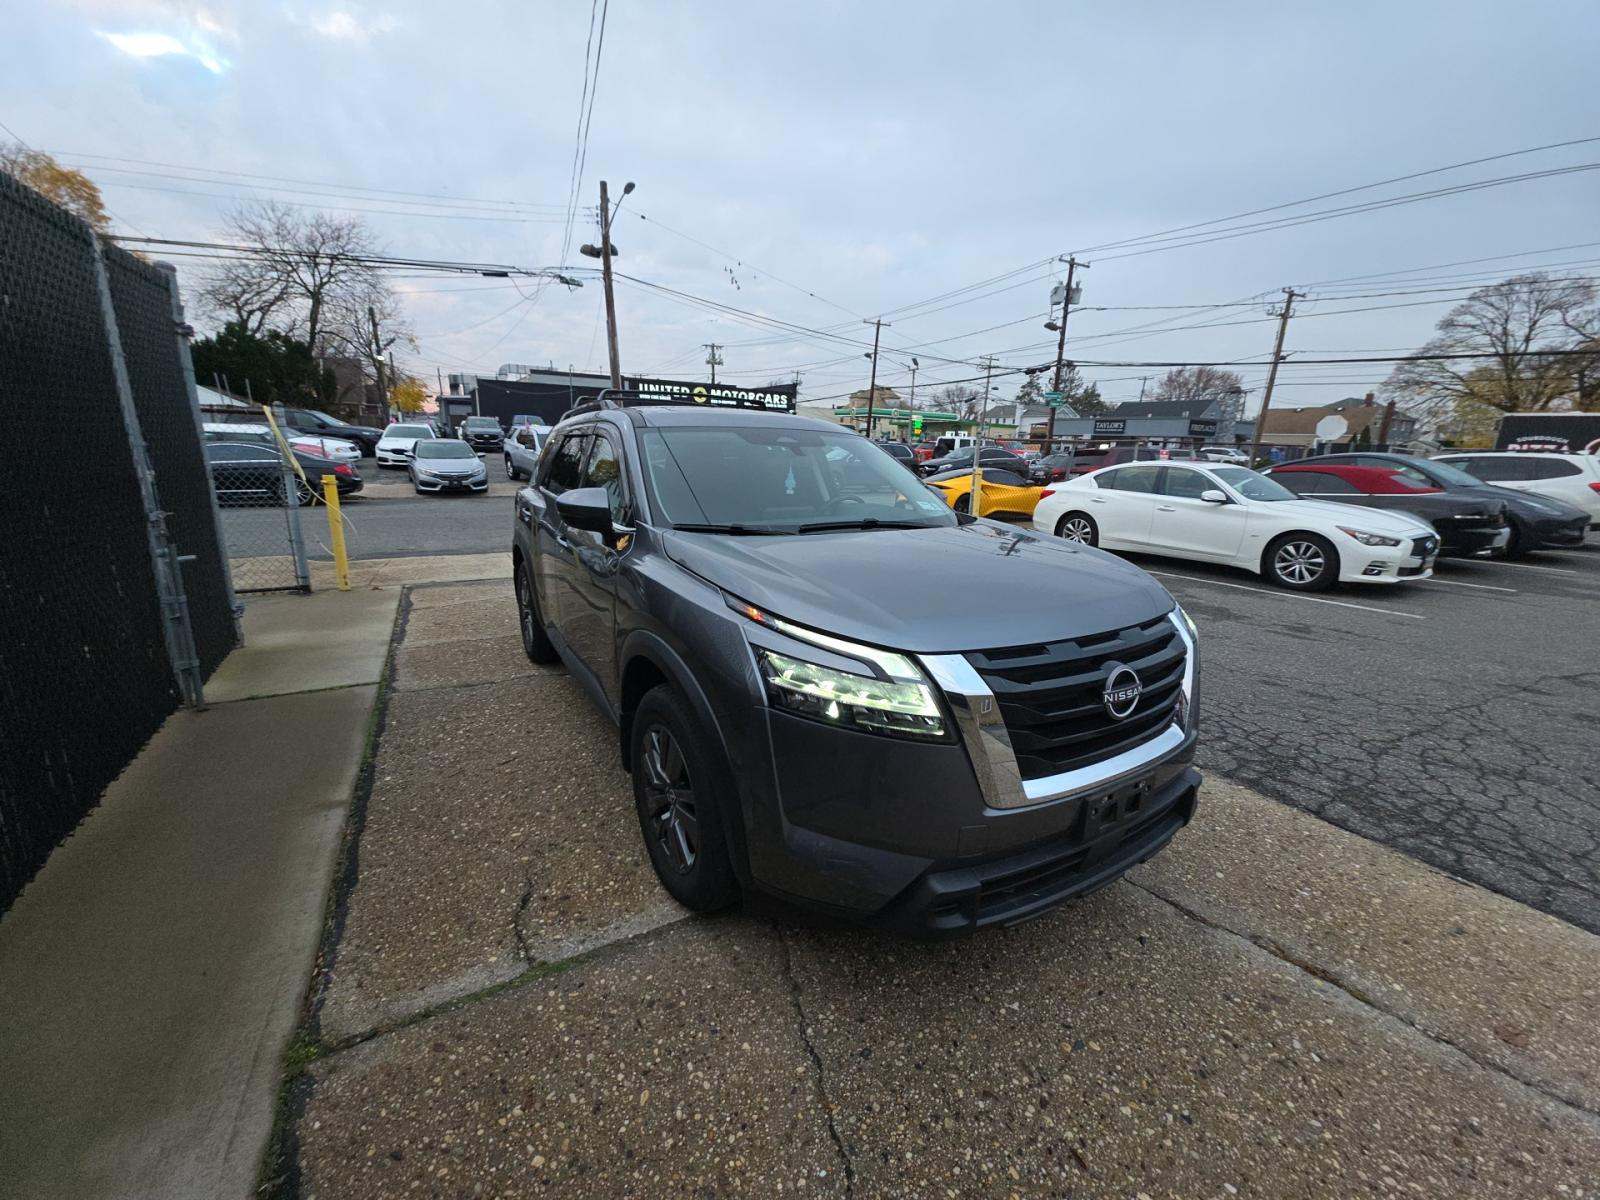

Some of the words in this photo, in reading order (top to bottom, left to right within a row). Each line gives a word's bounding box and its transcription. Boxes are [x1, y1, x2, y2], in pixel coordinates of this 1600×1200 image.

[639, 383, 690, 394] UNITED
[711, 388, 788, 404] MOTORCARS
[1104, 685, 1143, 703] NISSAN
